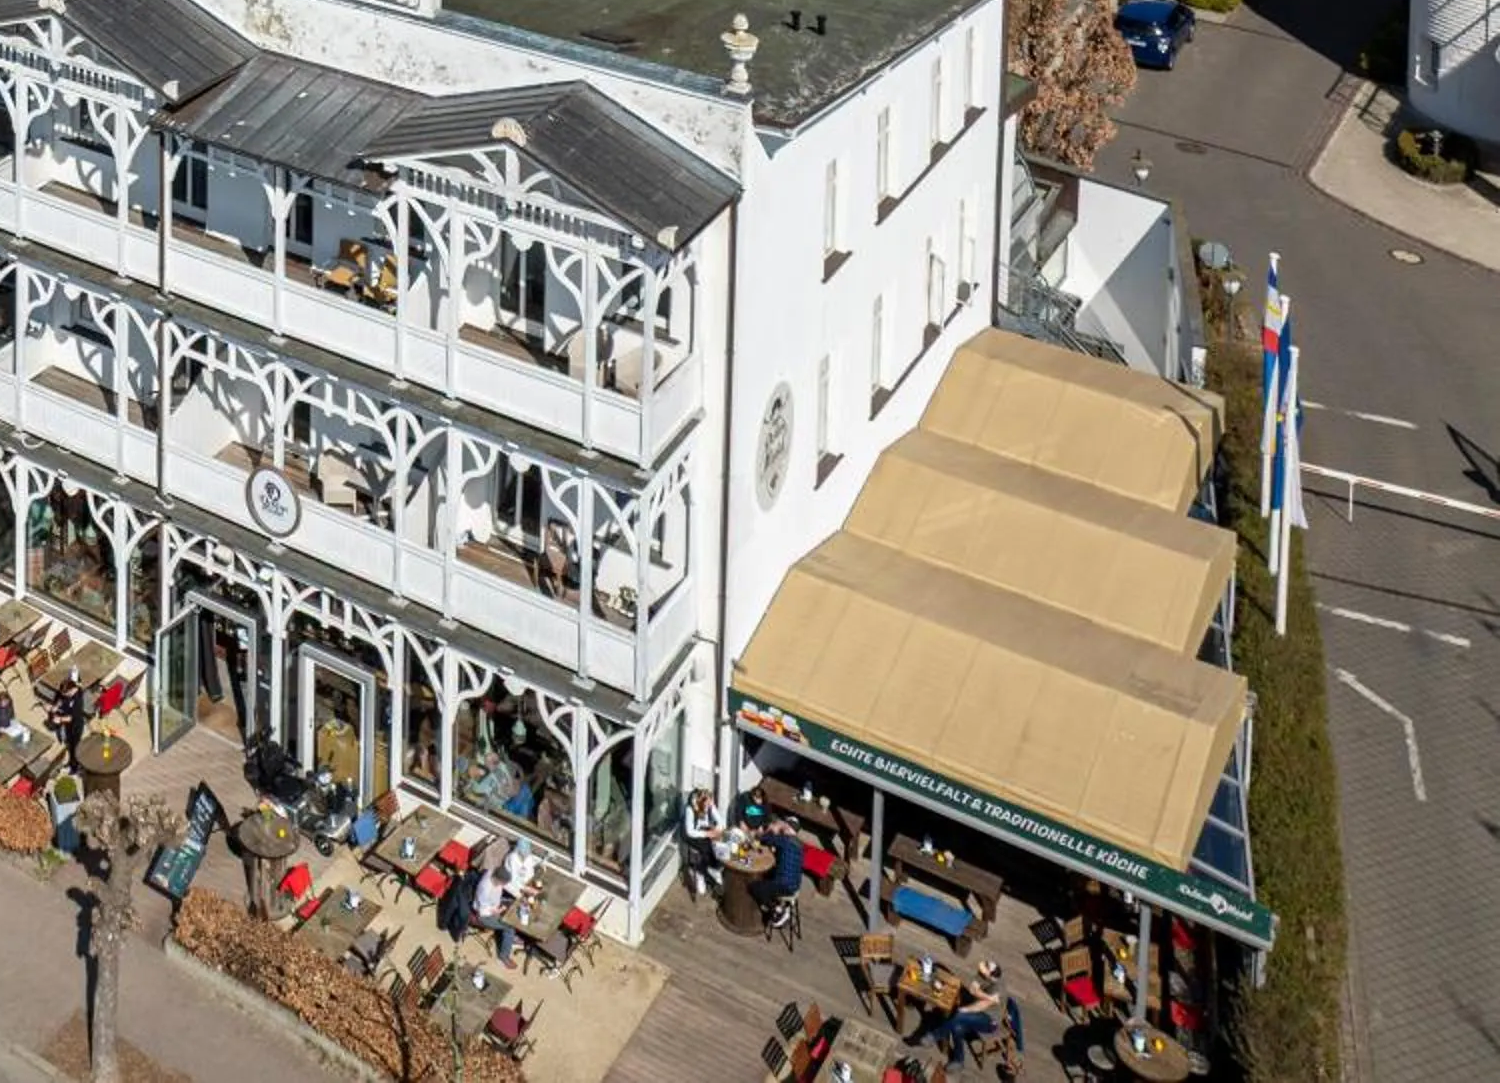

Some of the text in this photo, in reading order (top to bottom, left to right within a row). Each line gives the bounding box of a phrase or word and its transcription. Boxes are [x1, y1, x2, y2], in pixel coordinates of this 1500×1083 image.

[831, 739, 871, 765] ECHTE
[874, 756, 970, 805] BIERVIELFALT
[985, 802, 1094, 857] TRADITIONELLE
[1095, 848, 1149, 880] KÜCHE
